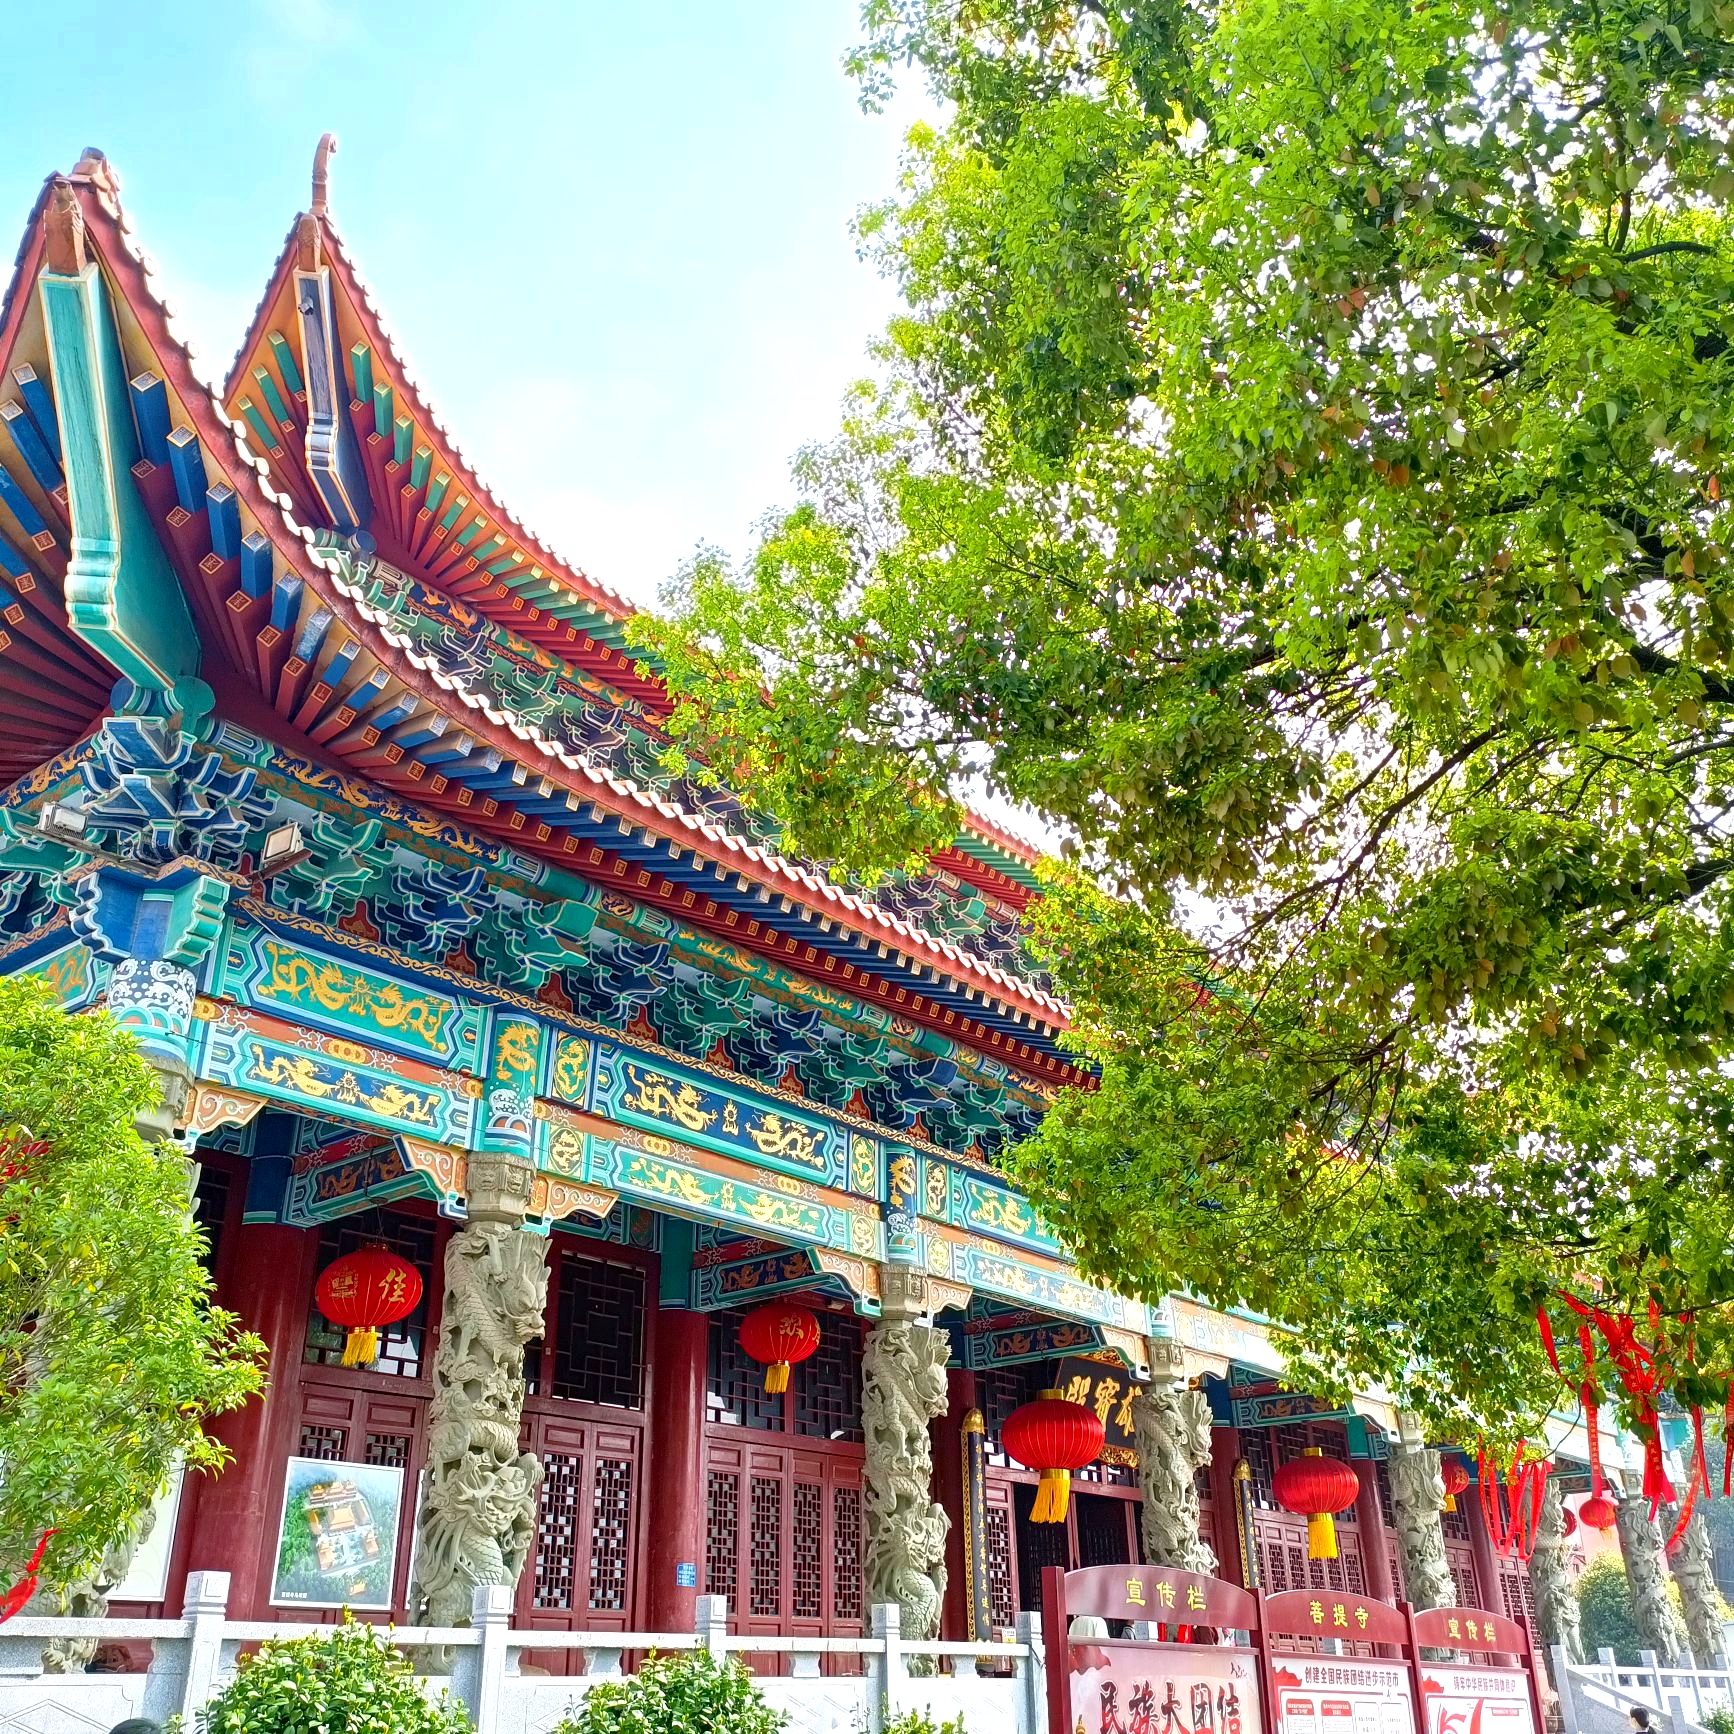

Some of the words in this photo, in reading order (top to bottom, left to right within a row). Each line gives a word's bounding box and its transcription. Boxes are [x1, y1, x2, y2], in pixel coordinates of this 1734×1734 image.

[1125, 1577, 1207, 1611] 宣传栏
[1309, 1599, 1369, 1629] 菩提寺
[1448, 1616, 1496, 1642] 宣传栏
[1304, 1665, 1399, 1688] 创建全国民族团结进步示范市
[1099, 1678, 1242, 1734] 民族大团结
